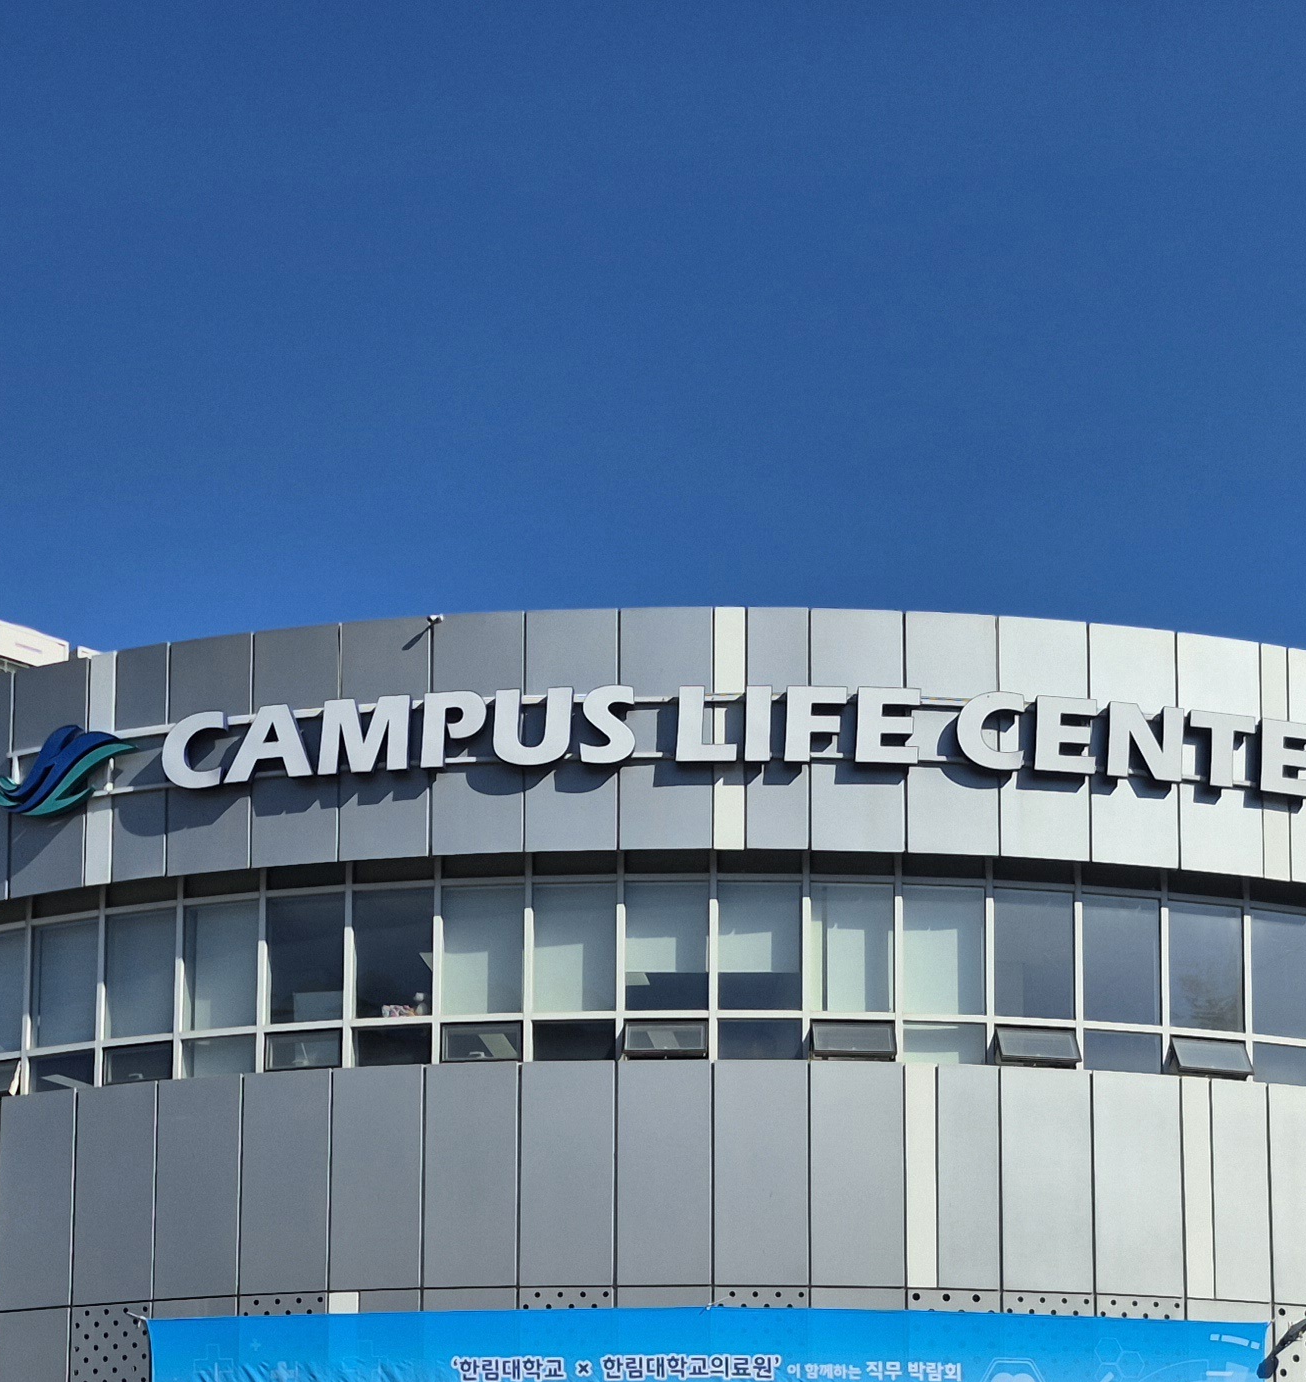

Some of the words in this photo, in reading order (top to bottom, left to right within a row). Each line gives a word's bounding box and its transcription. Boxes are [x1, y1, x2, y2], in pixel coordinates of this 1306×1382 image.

[161, 685, 635, 789] CAMPUS
[677, 685, 921, 764] LIFE
[804, 1362, 862, 1381] 함께하는
[866, 1360, 903, 1381] 직무
[908, 1361, 962, 1382] 박람회
